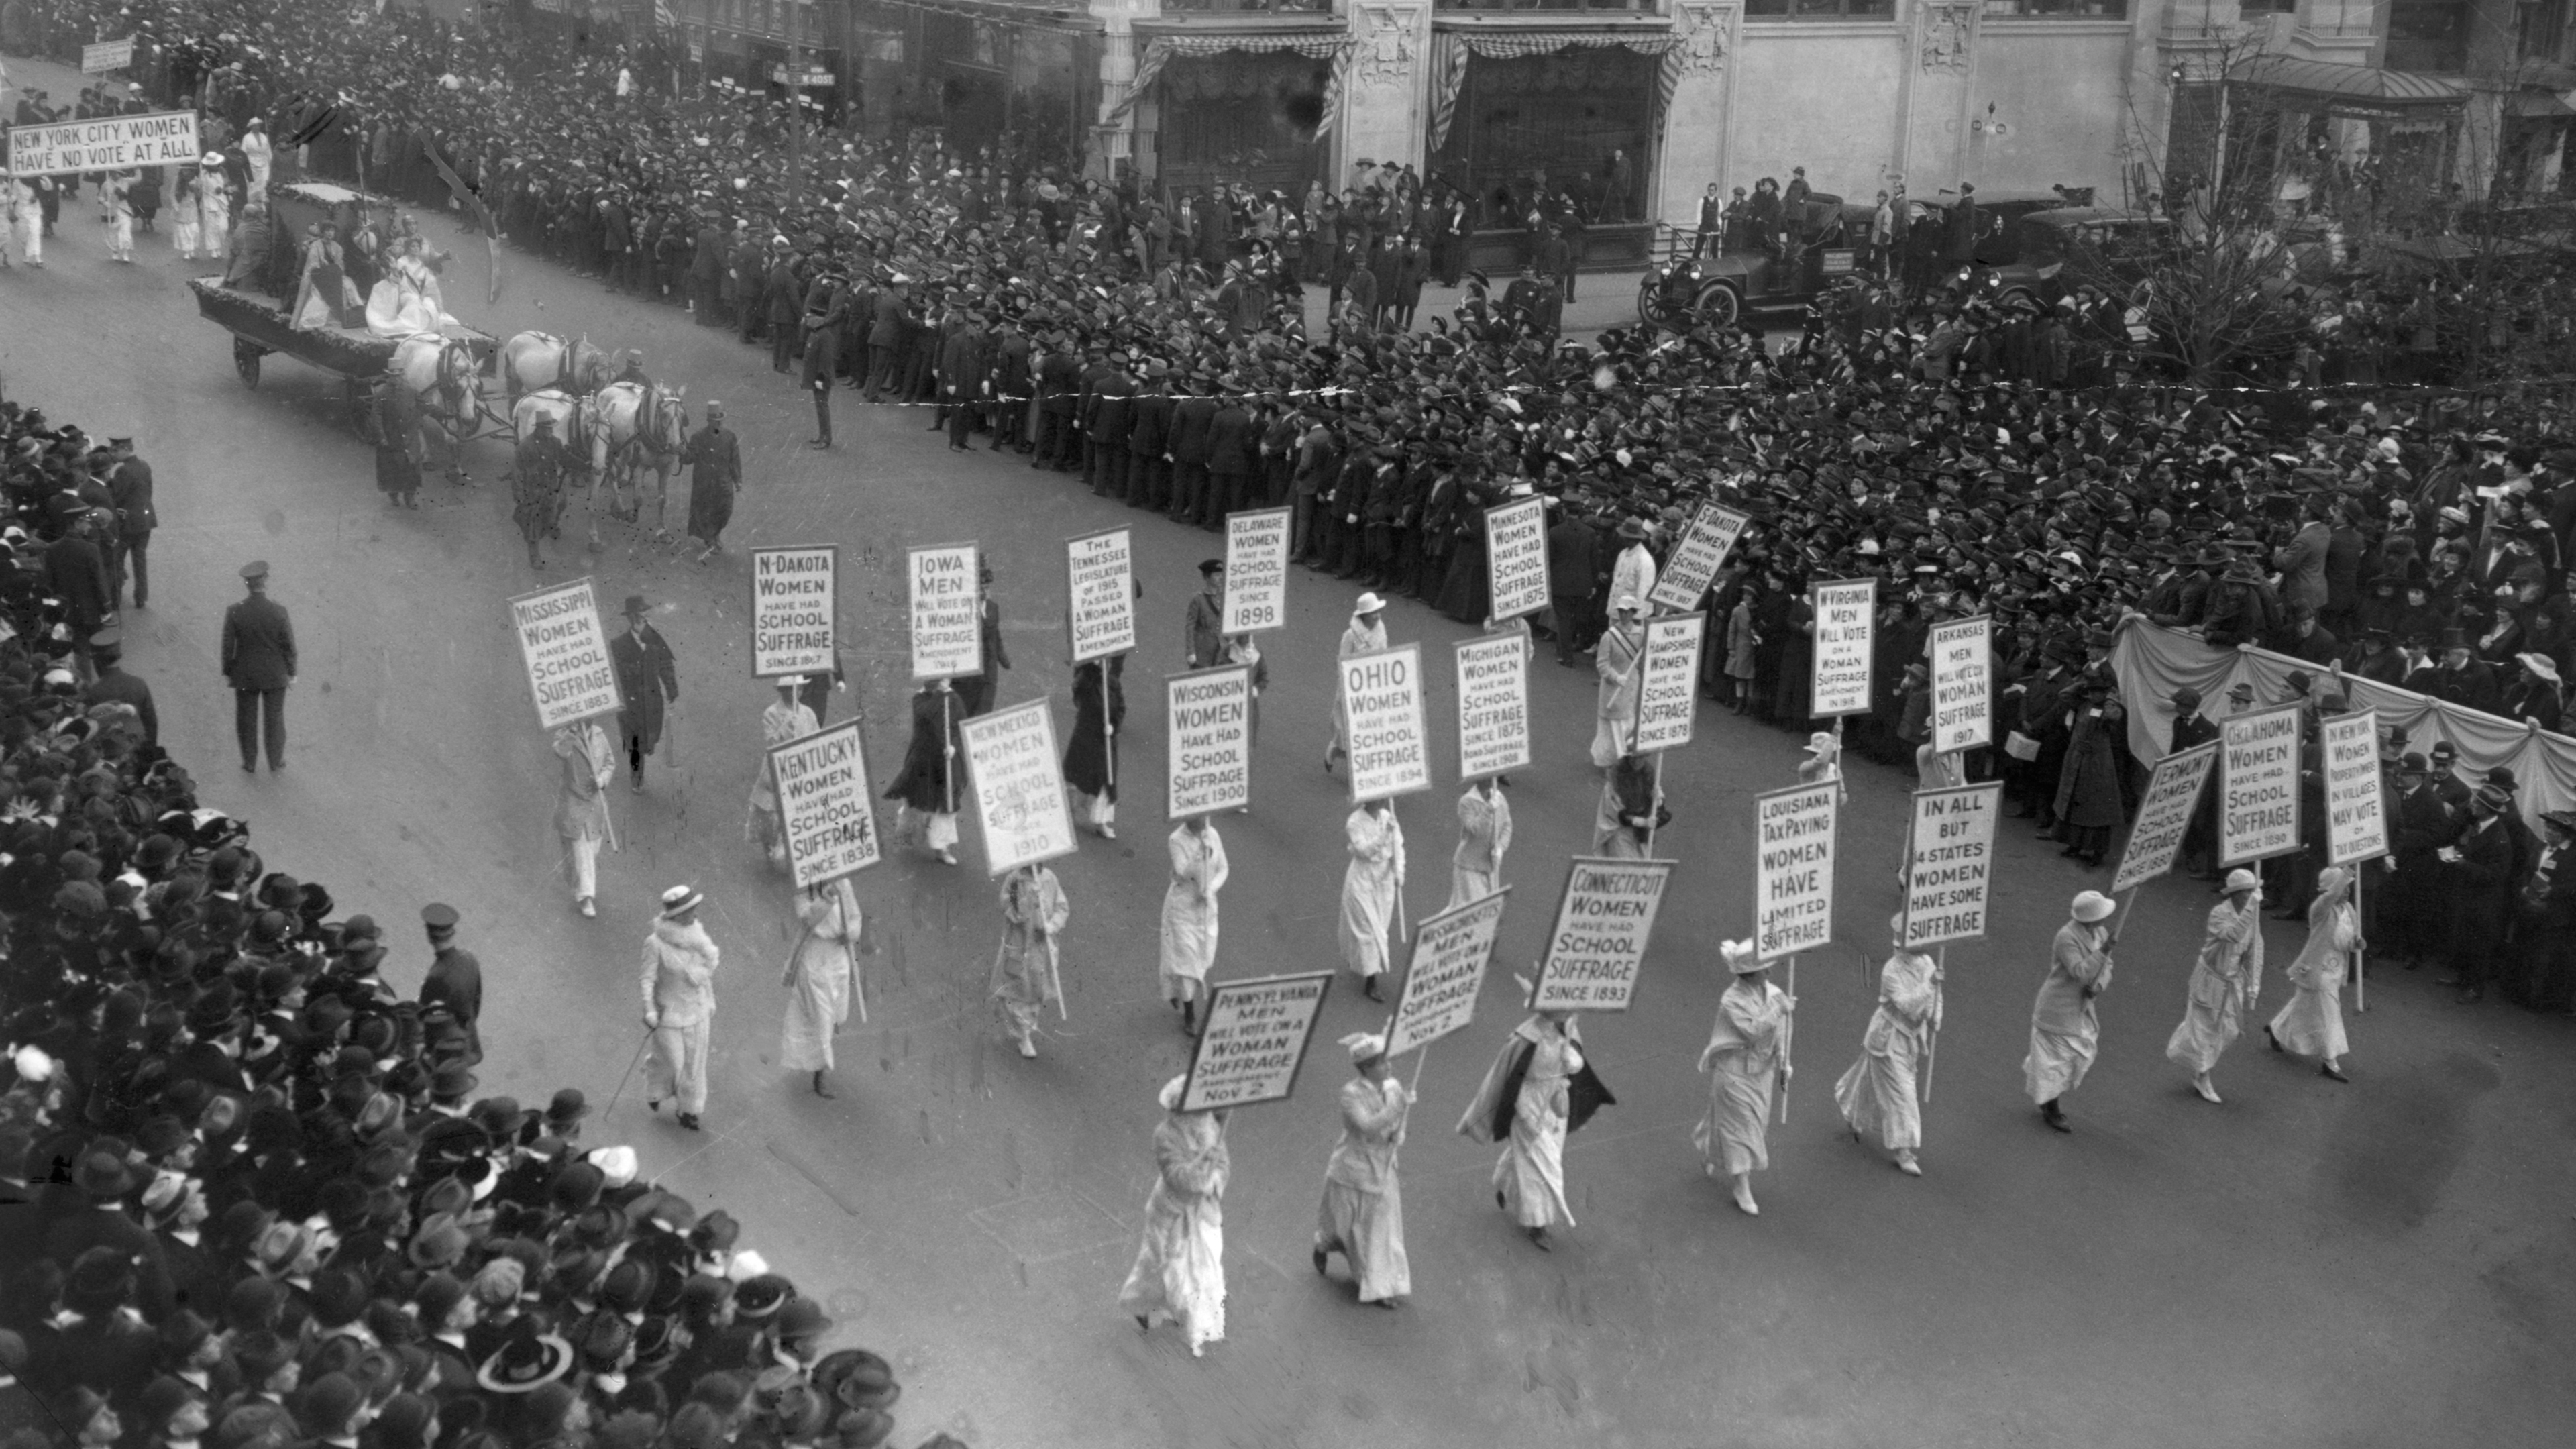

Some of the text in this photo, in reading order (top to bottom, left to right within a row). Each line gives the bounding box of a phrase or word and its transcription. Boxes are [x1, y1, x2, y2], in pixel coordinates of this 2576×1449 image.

[14, 117, 190, 150] NEW YORK CITY WOMEN
[15, 143, 153, 171] HAVE NO VOTE AT
[1232, 517, 1284, 533] DELAWARE
[1491, 506, 1540, 531] MINNESOTA
[1087, 539, 1111, 551] THE
[1234, 533, 1279, 548] WOMEN
[1494, 524, 1536, 547] WOMEN
[1689, 525, 1729, 551] WOMEN
[1072, 549, 1127, 570] TENNESSEE
[1494, 539, 1540, 563] HAVE HAD
[1074, 563, 1128, 585] LEGISLATURE
[1230, 560, 1281, 576] SCHOOL
[1495, 557, 1542, 580] SCHOOL
[1673, 553, 1712, 576] SCHOOL
[759, 578, 825, 596] WOMEN
[920, 577, 963, 596] MEN
[1084, 579, 1118, 595] OF 1915
[1229, 575, 1281, 591] SUFFRAGE
[1495, 572, 1544, 597] SUFFRAGE
[1662, 566, 1707, 594] SUFFRAGE
[515, 590, 592, 626] MISSISSIPPI
[765, 600, 820, 611] HAVE HAD
[1081, 591, 1122, 608] PASSED
[1239, 592, 1269, 604] SINCE
[1497, 588, 1545, 612] SINCE 1875
[759, 612, 828, 629] SCHOOL
[915, 612, 973, 629] A WOMAN
[1076, 603, 1126, 624] A WOMAN
[1235, 606, 1274, 626] 1898
[1831, 609, 1857, 623] MEN
[524, 617, 590, 647] WOMEN
[914, 629, 975, 647] SUFFRAGE
[1076, 616, 1130, 641] SUFFRAGE
[1663, 626, 1686, 637] NEW
[1819, 627, 1866, 643] WILL VOTE
[1937, 625, 1984, 644] ARKANSAS
[537, 637, 592, 659] HAVE HAD
[758, 631, 830, 652] SUFFRAGE
[1080, 633, 1132, 653] AMENDMENT
[1649, 637, 1697, 654] HAMPSHIRE
[533, 649, 604, 680] SCHOOL
[765, 656, 798, 668] SINCE
[1461, 643, 1519, 664] MICHIGAN
[1650, 655, 1689, 671] WOMEN
[1822, 657, 1862, 669] WOMAN
[1950, 647, 1972, 663] MEN
[1350, 660, 1406, 692] OHIO
[1464, 660, 1518, 680] WOMEN
[1817, 672, 1867, 686] SUFFRAGE
[1938, 672, 1954, 684] WILL
[537, 667, 612, 704] SUFFRAGE
[1173, 680, 1244, 705] WISCONSIN
[1470, 677, 1515, 692] HAVE HAD
[1644, 686, 1687, 702] SCHOOL
[1938, 681, 1986, 704] WOMAN
[549, 694, 610, 720] SINCE 1883
[1350, 690, 1411, 715] WOMEN
[1464, 690, 1519, 710] SCHOOL
[1175, 702, 1243, 730] WOMEN
[1357, 713, 1410, 730] HAVE HAD
[1463, 705, 1523, 730] SUFFRAGE
[1642, 701, 1690, 724] SUFFRAGE
[1939, 702, 1986, 727] SUFFRAGE
[1182, 729, 1241, 749] HAVE HAD
[1353, 729, 1416, 750] SCHOOL
[1465, 722, 1524, 745] SINCE 1875
[1640, 727, 1666, 743] SINCE
[1954, 729, 1974, 743] 1917
[2228, 716, 2294, 747] OKLAHOMA
[777, 735, 856, 782] KENTUCKY
[977, 731, 1044, 764] WOMEN
[1354, 744, 1420, 772] SUFFRAGE
[2229, 745, 2288, 771] WOMEN
[2334, 742, 2370, 763] WOMEN
[1181, 750, 1240, 771] SCHOOL
[2153, 753, 2213, 788] VERMONT
[787, 767, 852, 800] WOMEN
[983, 773, 1055, 806] SCHOOL
[1173, 768, 1244, 794] SUFFRAGE
[1358, 775, 1391, 790] SINCE
[2231, 773, 2258, 787] HAVE
[2331, 780, 2377, 803] IN VILLAGES
[829, 787, 853, 802] HAD
[1175, 784, 1245, 810] SINCE 1900
[2147, 777, 2201, 807] WOMEN
[2229, 785, 2289, 810] SCHOOL
[1763, 793, 1830, 820] LOUISIANA
[1925, 795, 1983, 817] IN ALL
[2333, 801, 2378, 827] MAY VOTE
[790, 800, 863, 836] SCHOOL
[2135, 812, 2186, 839] SCHOOL
[2227, 805, 2293, 837] SUFFRAGE
[794, 816, 872, 861] SUFFRAGE
[1940, 821, 1970, 839] BUT
[1014, 835, 1049, 858] 1910
[1929, 843, 1984, 863] STATES
[2125, 827, 2183, 864] SUFFRAGE
[2234, 833, 2286, 853] SINCE 1890
[800, 843, 875, 881] SINCE 1838
[1763, 841, 1827, 871] WOMEN
[1574, 869, 1664, 896] CONNECTICUT
[1772, 870, 1819, 900] HAVE
[1914, 864, 1985, 888] WOMEN
[1570, 896, 1648, 917] WOMEN
[1911, 887, 1982, 912] HAVE SOME
[1761, 898, 1827, 926] LIMITED
[1761, 918, 1825, 952] SUFFRAGE
[1909, 911, 1981, 941] SUFFRAGE
[1433, 930, 1474, 954] MEN
[1556, 932, 1637, 954] SCHOOL
[1411, 960, 1479, 996] WOMAN
[1548, 957, 1636, 981] SUFFRAGE
[1403, 977, 1479, 1016] SUFFRAGE
[1544, 987, 1627, 1001] SINCE 1893
[1237, 1006, 1286, 1021] MEN
[1408, 1022, 1437, 1042] NOV
[1211, 1037, 1289, 1058] WOMAN
[1197, 1053, 1293, 1078] SUFFRAGE
[1204, 1087, 1242, 1103] NOV
